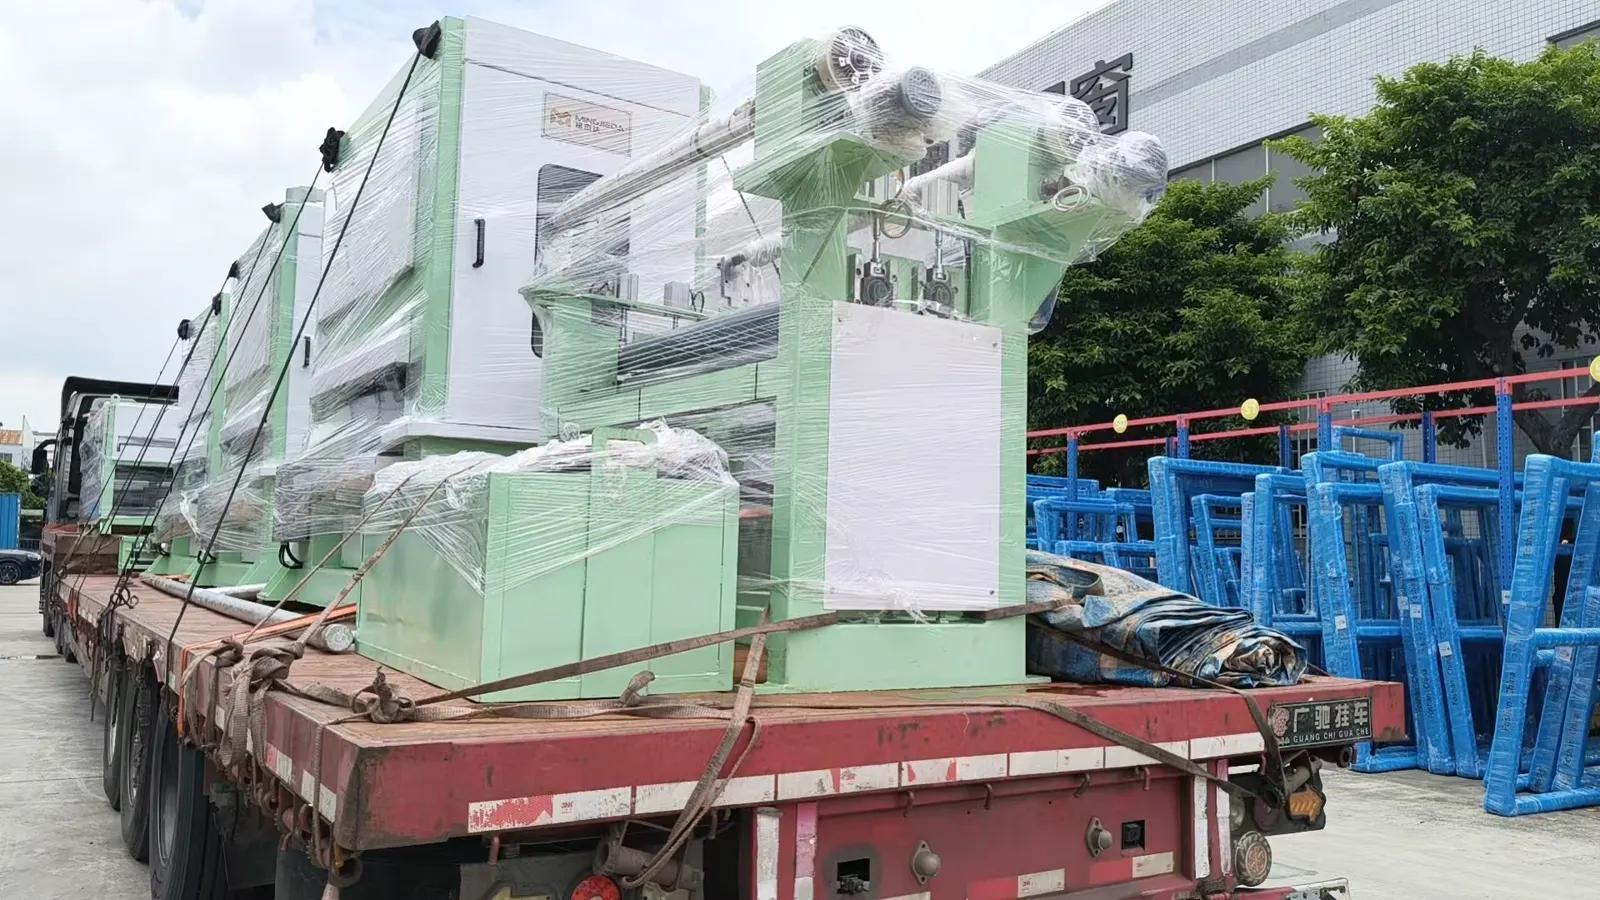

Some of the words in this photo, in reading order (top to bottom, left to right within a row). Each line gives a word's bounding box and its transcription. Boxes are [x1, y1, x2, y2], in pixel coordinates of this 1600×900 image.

[1292, 701, 1369, 732] 广驰挂车
[1502, 701, 1514, 732] Foshan
[1293, 732, 1320, 743] GUANG
[1323, 731, 1336, 740] CHI
[1338, 729, 1354, 738] GUA
[1356, 728, 1369, 736] CHE
